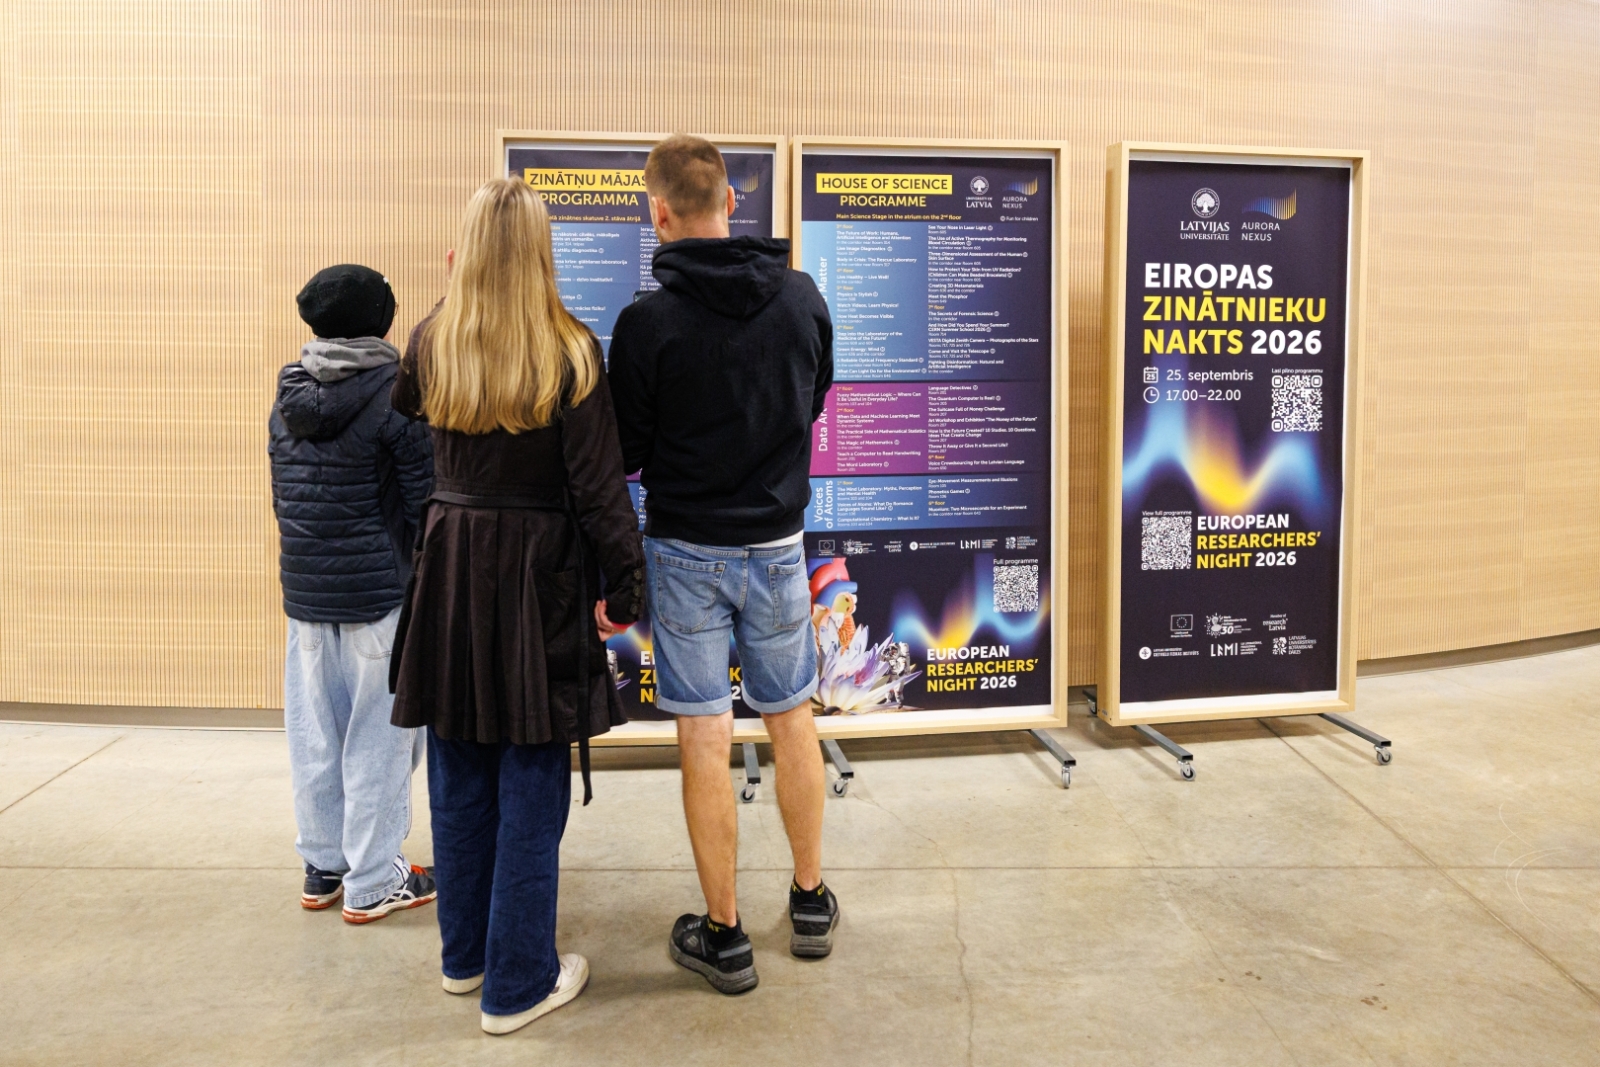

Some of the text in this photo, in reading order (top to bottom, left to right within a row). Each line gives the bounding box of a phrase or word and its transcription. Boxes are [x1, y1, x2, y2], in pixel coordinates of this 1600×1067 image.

[530, 171, 596, 188] ZINĀTŅU
[822, 178, 947, 190] HOUSE OF SCIENCE
[540, 193, 638, 205] PROGRAMMA
[840, 196, 926, 206] PROGRAMME
[1180, 221, 1229, 232] LATVIJAS
[1241, 222, 1280, 230] AURORA
[1242, 233, 1271, 241] NEXUS
[818, 257, 827, 292] Matter
[1145, 263, 1273, 289] EIROPAS
[1143, 291, 1326, 322] ZINĀTNIEKU
[1143, 329, 1322, 354] NAKTS 2026
[1166, 369, 1253, 383] 25. septembris
[819, 427, 828, 451] Data
[814, 487, 823, 523] Voices
[824, 480, 833, 528] of Atoms
[1198, 514, 1289, 531] EUROPEAN
[1197, 552, 1296, 569] NIGHT 2026
[1221, 626, 1234, 634] 30
[927, 645, 1009, 661] EUROPEAN
[927, 675, 1017, 692] NIGHT 2026
